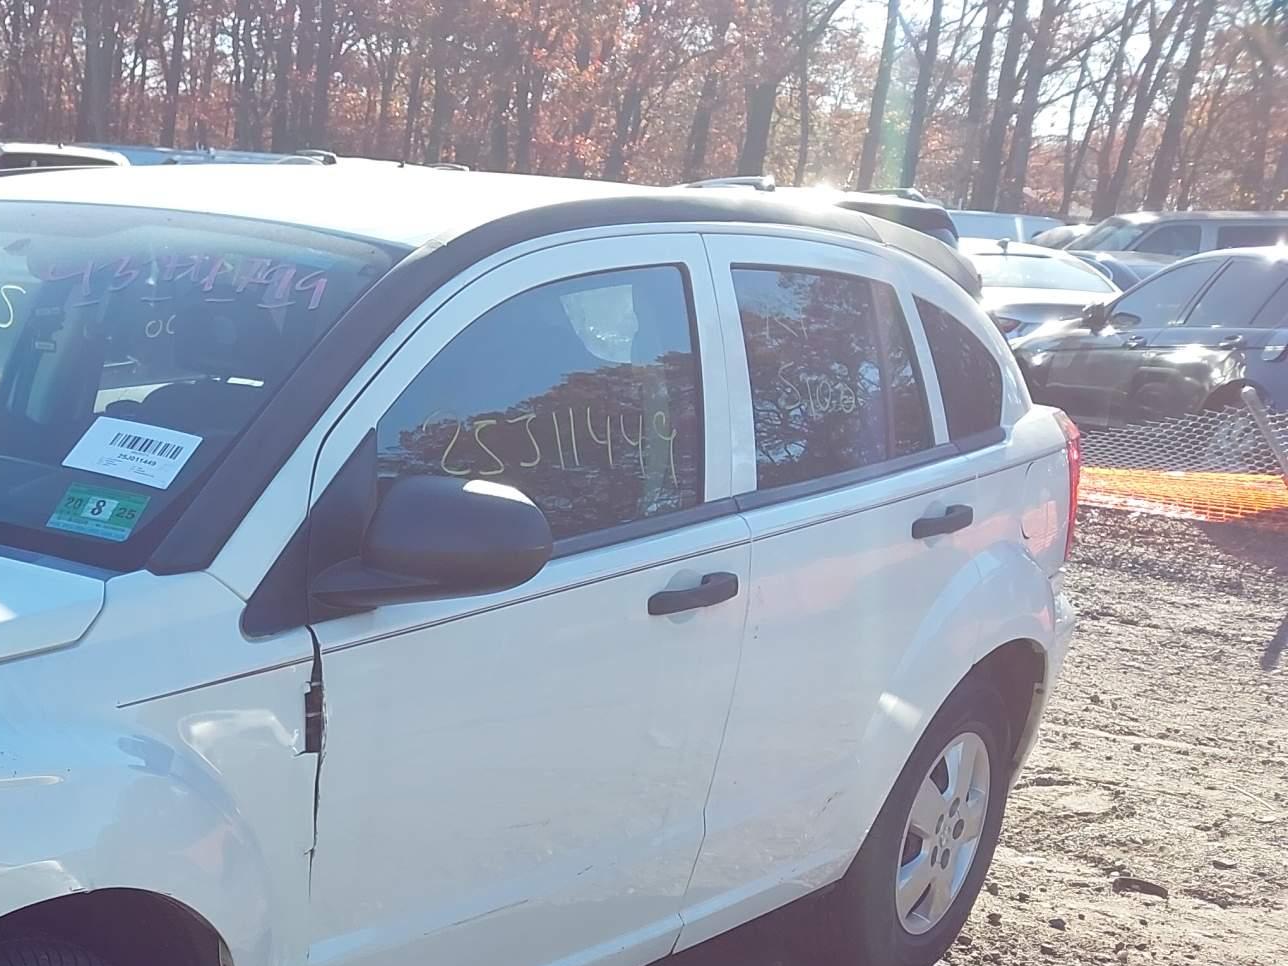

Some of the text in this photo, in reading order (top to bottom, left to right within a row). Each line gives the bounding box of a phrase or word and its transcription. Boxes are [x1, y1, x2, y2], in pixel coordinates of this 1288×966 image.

[422, 407, 678, 488] 25J11449
[91, 500, 106, 516] 8
[116, 507, 137, 519] 25
